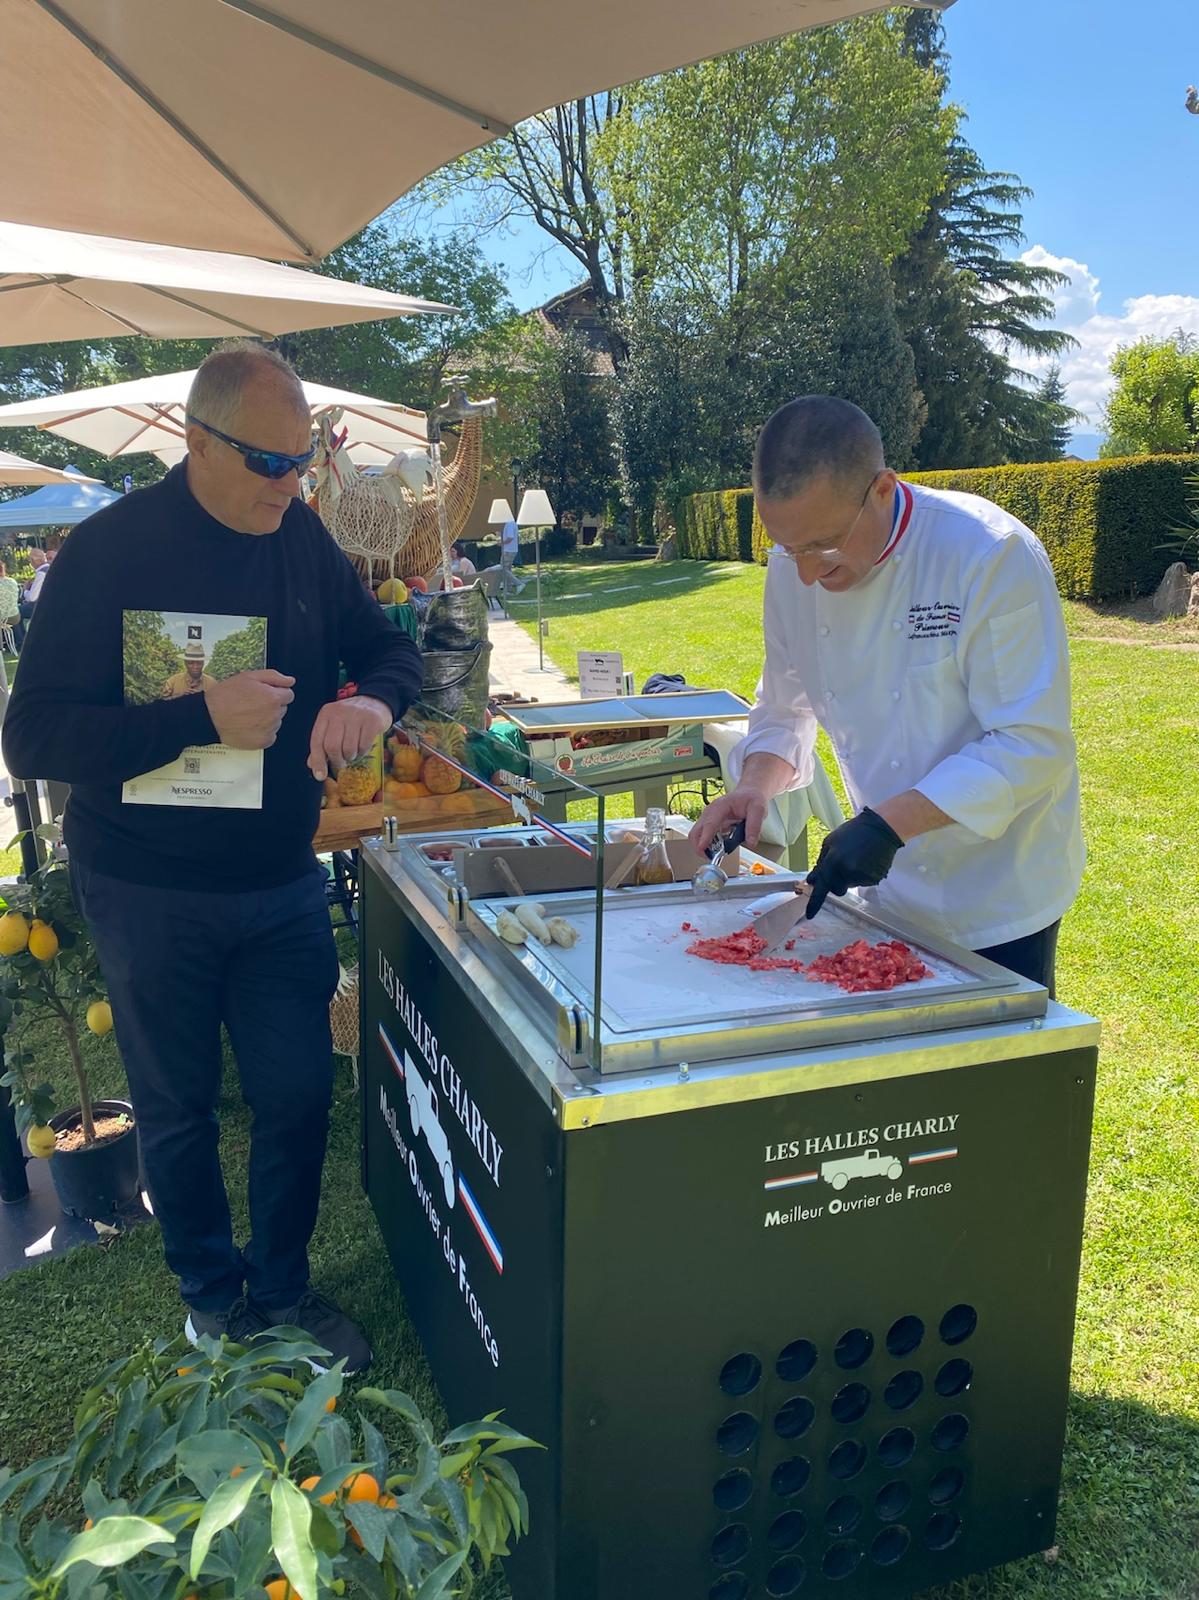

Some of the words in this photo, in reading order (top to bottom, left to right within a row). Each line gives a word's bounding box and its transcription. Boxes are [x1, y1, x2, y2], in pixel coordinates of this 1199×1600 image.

[171, 786, 213, 796] NESPRESSO
[377, 948, 394, 1001] LES
[395, 975, 439, 1076] HALLES
[440, 1053, 504, 1189] CHARLY
[764, 1140, 800, 1163] LES
[805, 1127, 880, 1156] HALLES
[883, 1113, 960, 1142] CHARLY
[379, 1083, 408, 1165] Meilleur
[408, 1150, 440, 1239] Ouvrier
[442, 1225, 456, 1274] de
[459, 1254, 500, 1368] France
[764, 1204, 824, 1228] Meilleur
[828, 1194, 881, 1215] Ouvrier
[885, 1187, 903, 1204] de
[907, 1180, 952, 1200] France
